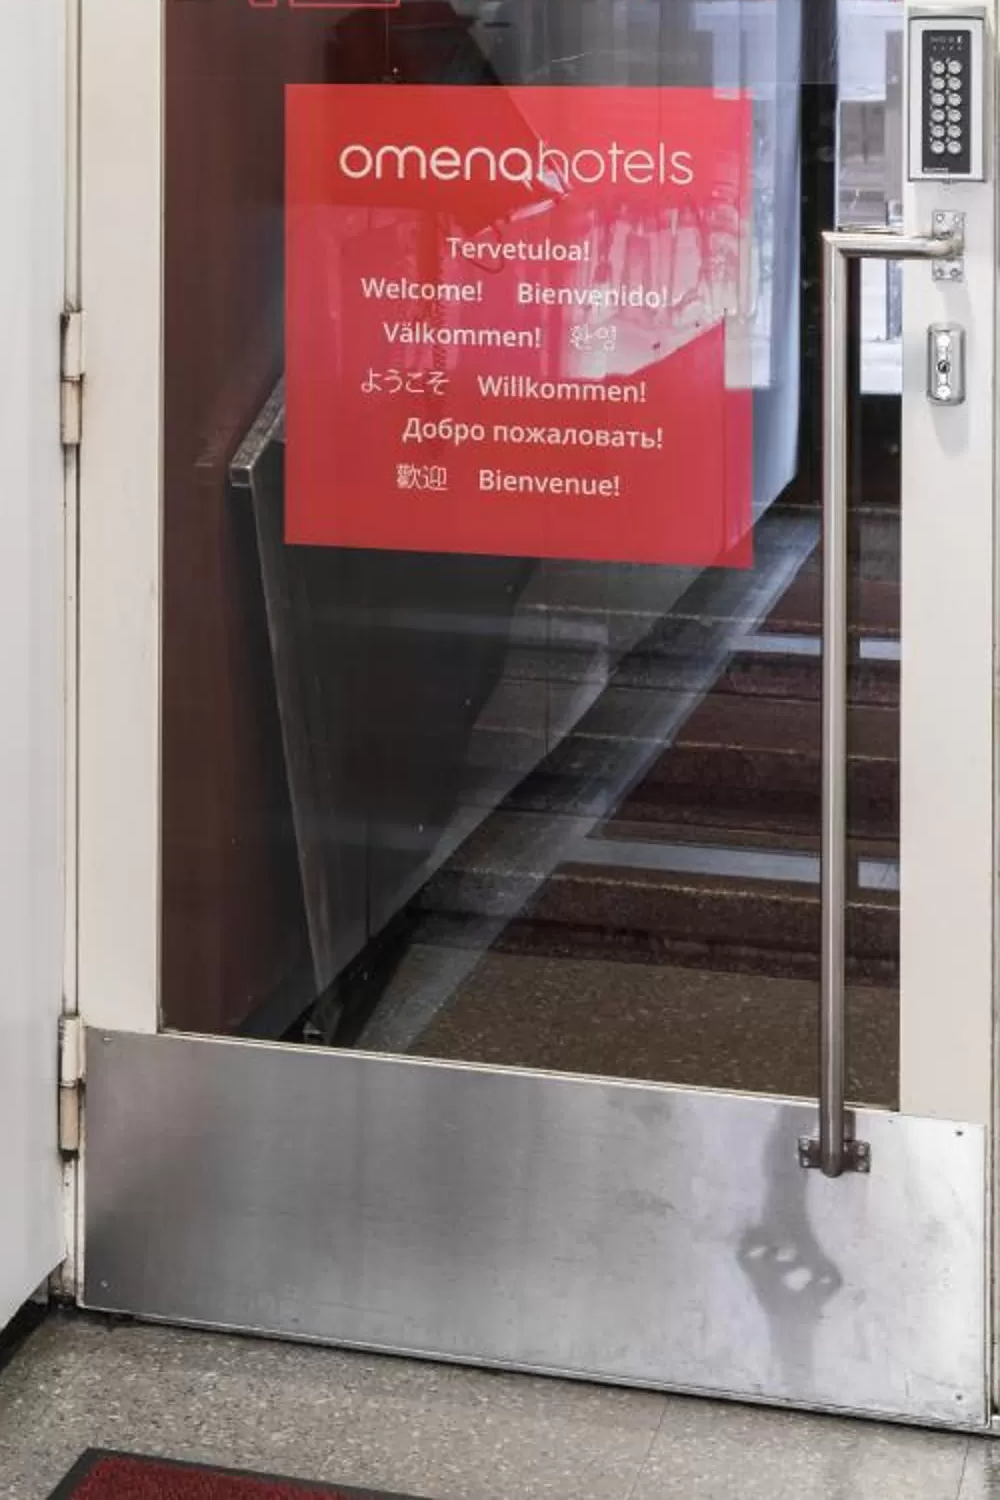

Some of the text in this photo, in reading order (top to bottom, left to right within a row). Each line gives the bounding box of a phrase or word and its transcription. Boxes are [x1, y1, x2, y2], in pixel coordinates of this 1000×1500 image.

[339, 140, 694, 185] omenahotels
[446, 237, 590, 261] Tervetuloa!
[361, 277, 668, 308] Welcome! Bienvenido!
[383, 322, 542, 348] Välkommen!
[361, 368, 647, 403] ようこそ Willkommen!
[402, 417, 664, 449] Добро пожаловать!
[479, 469, 621, 497] Bienvenue!
